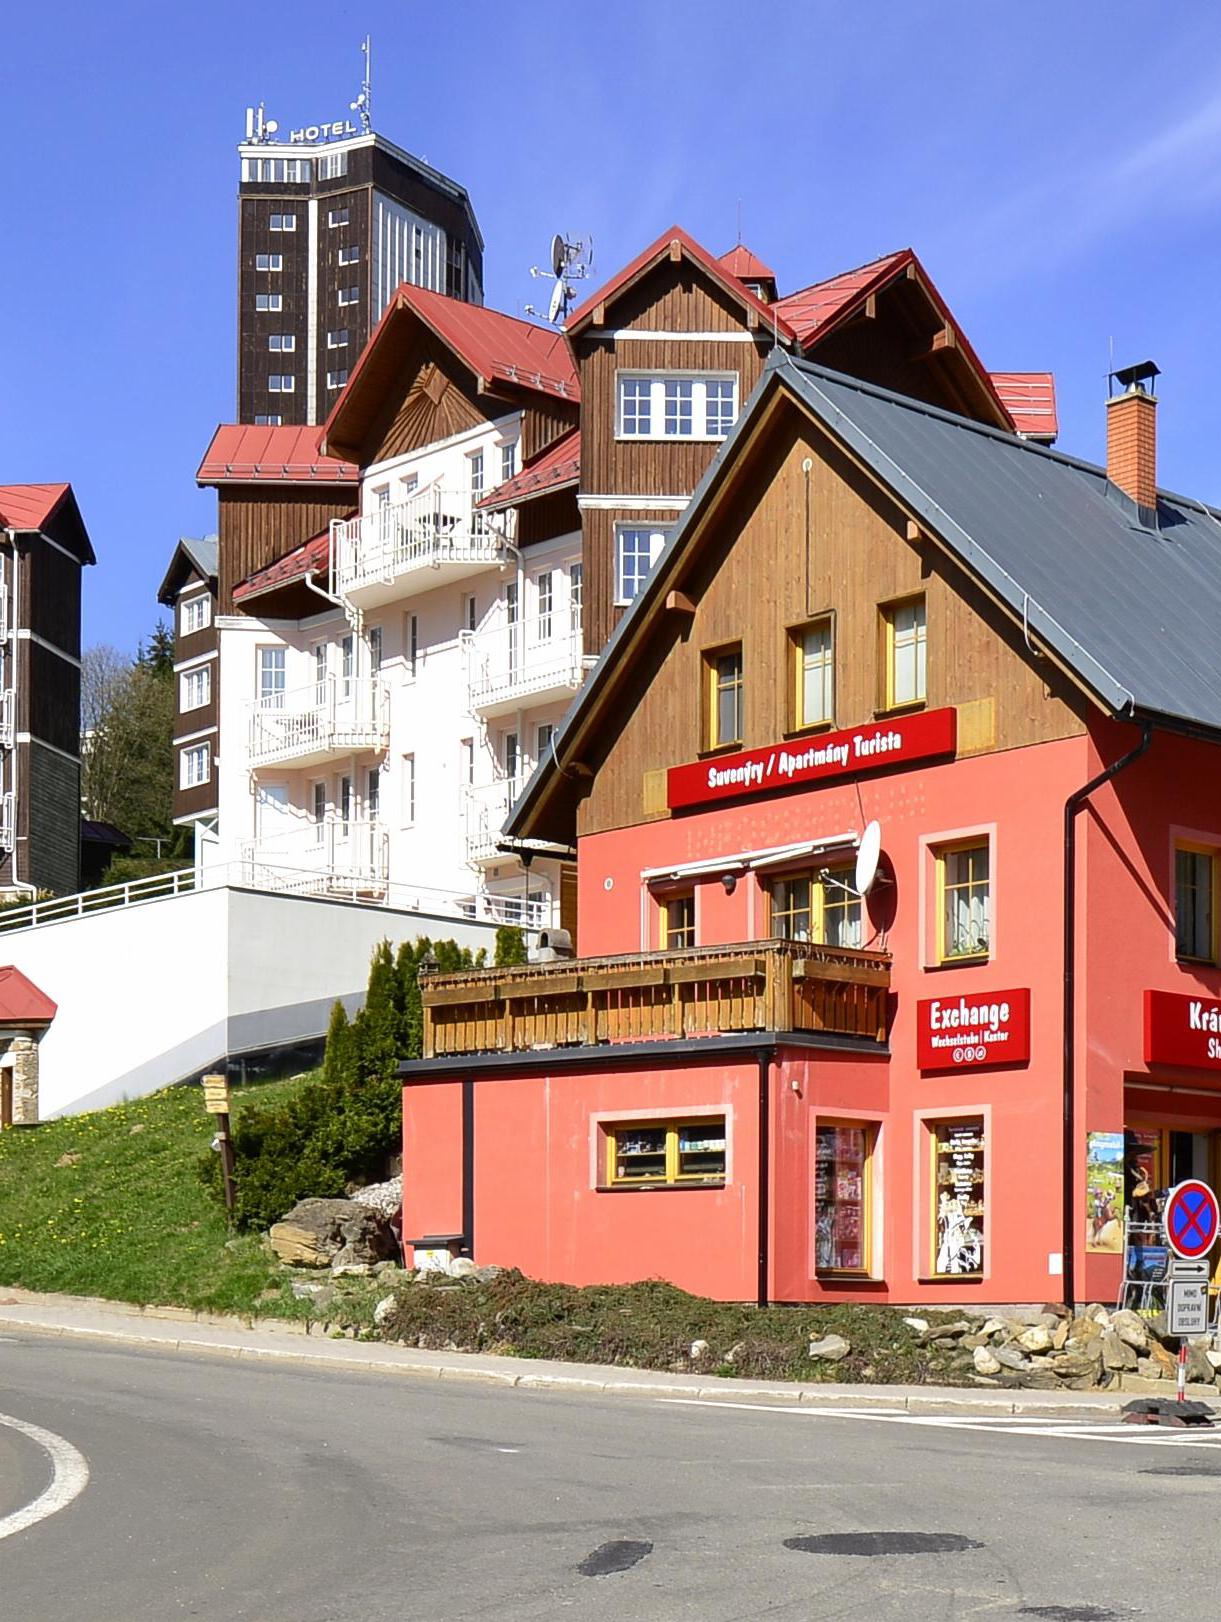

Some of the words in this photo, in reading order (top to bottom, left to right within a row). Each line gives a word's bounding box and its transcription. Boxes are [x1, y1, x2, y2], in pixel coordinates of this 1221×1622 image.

[290, 120, 357, 143] HOTEL
[708, 760, 764, 789] Suvenýry
[778, 743, 850, 777] Apartmány
[853, 731, 902, 758] Turista
[930, 998, 1010, 1031] Exchange
